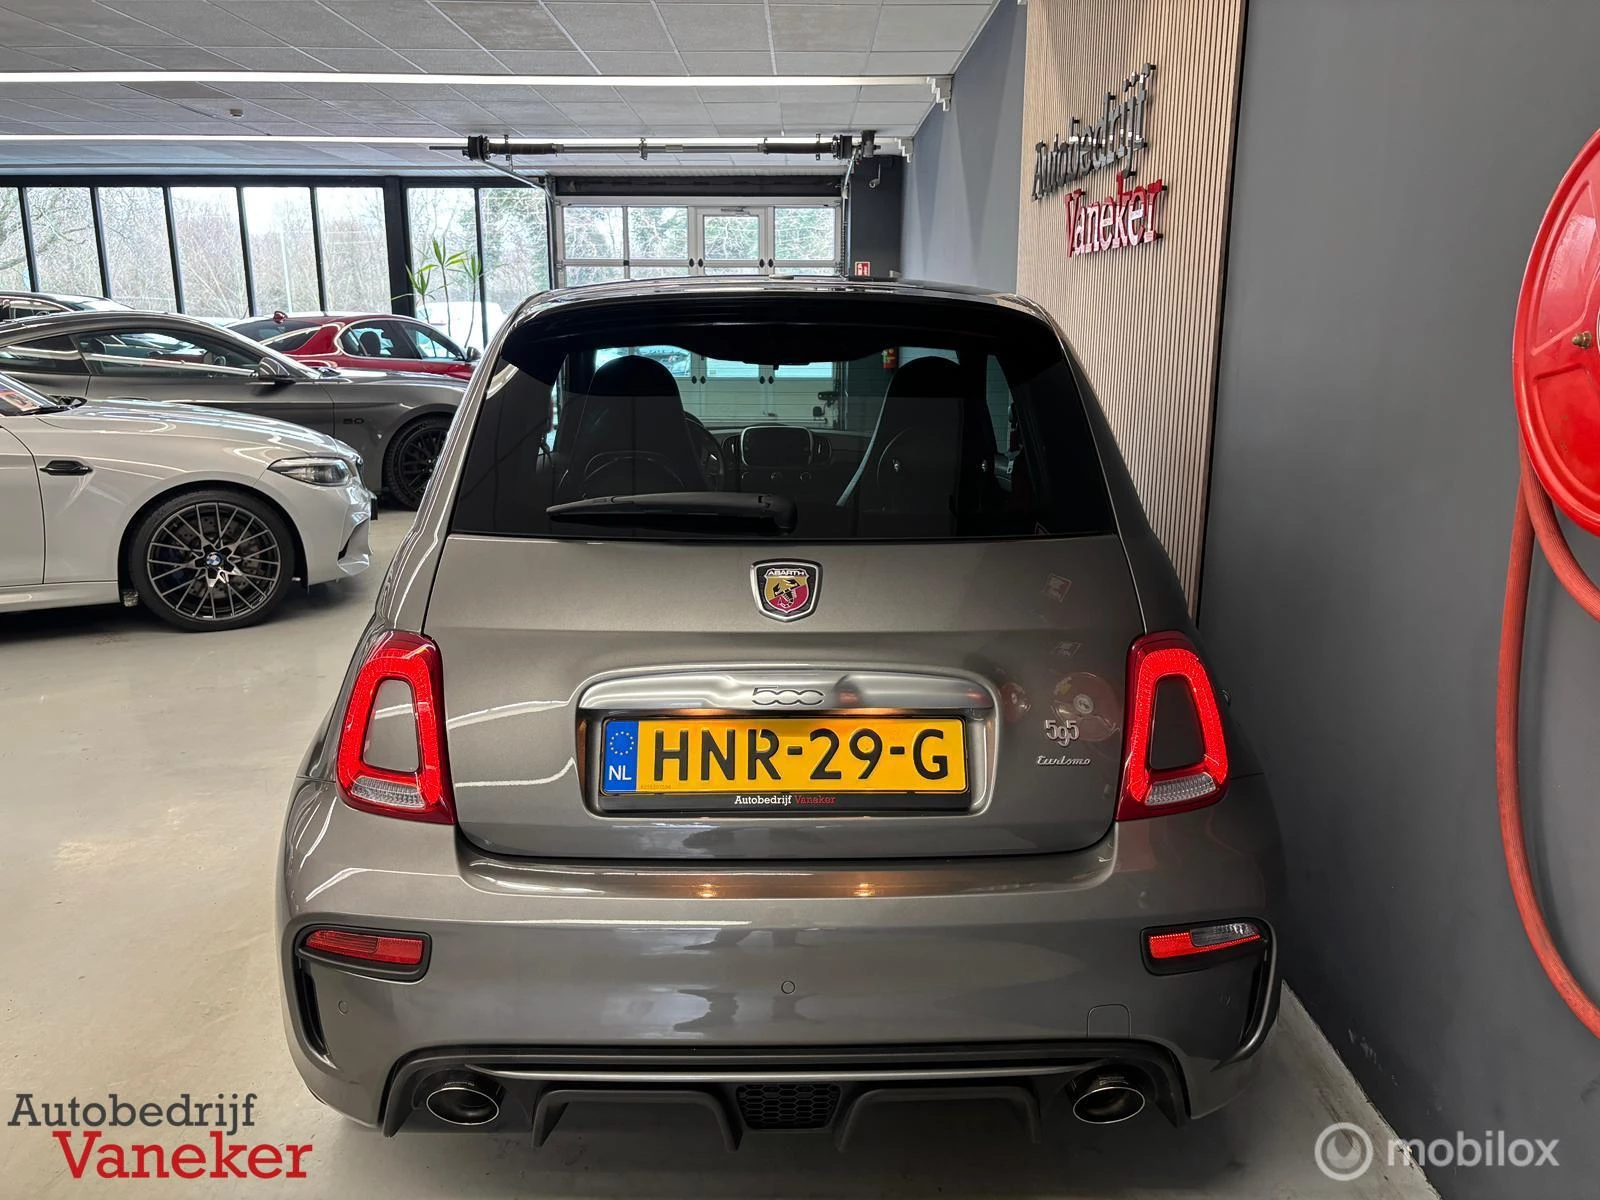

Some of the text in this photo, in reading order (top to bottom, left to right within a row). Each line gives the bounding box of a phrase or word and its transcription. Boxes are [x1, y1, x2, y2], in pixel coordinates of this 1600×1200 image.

[1032, 63, 1154, 202] Autobedrijf
[1064, 170, 1163, 258] Vaneker
[752, 685, 824, 706] 500
[1044, 719, 1080, 747] 595
[653, 727, 949, 782] HNR-29-G
[608, 765, 632, 781] NL
[734, 794, 837, 806] Autobedrijf Vaneker
